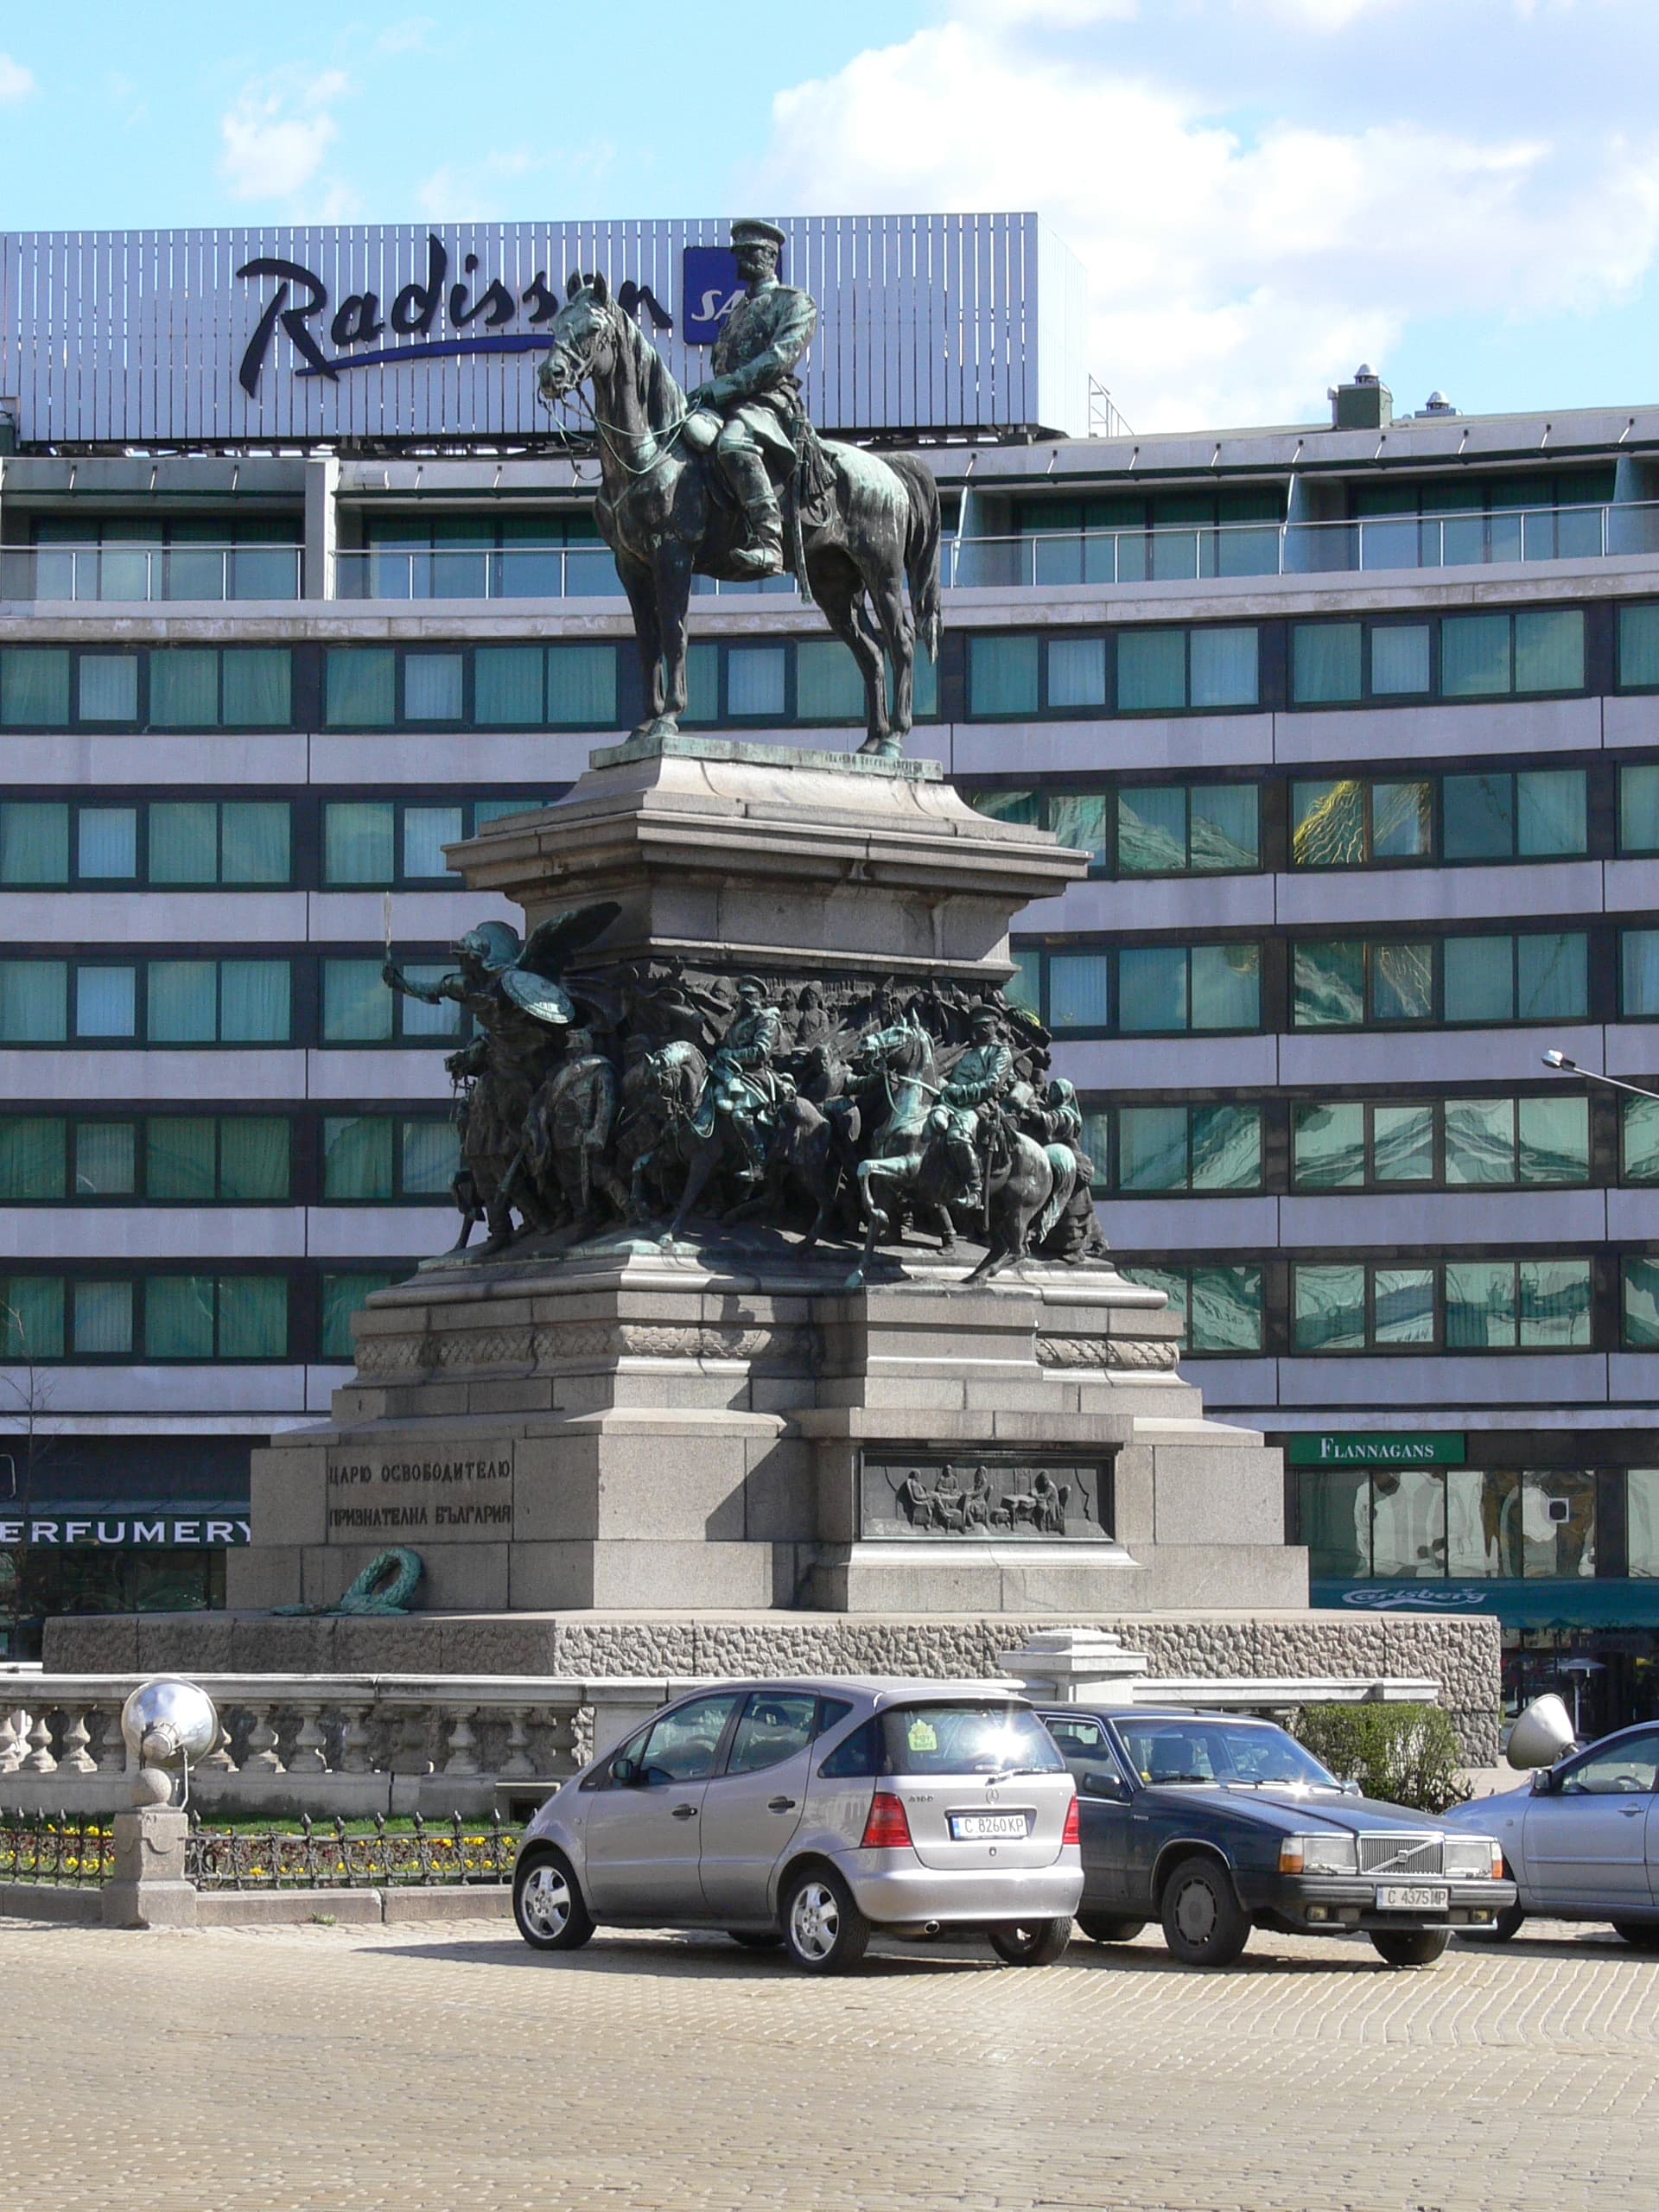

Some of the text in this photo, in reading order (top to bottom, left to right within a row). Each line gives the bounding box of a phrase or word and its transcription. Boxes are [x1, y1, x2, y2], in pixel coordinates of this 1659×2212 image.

[236, 232, 673, 399] Radissn
[691, 289, 746, 321] SA
[1320, 1438, 1434, 1459] FLANNAGANS
[328, 1460, 511, 1485] ЦАРЮ ОСВОБОДИТЕЛЮ
[328, 1504, 512, 1527] ПРИЗНАТЕЛНА БЪЛГАРИЯ
[1342, 1588, 1487, 1608] Carlsberg
[979, 1817, 1007, 1833] 8260
[1008, 1817, 1024, 1833] KP
[1401, 1890, 1429, 1905] 4375
